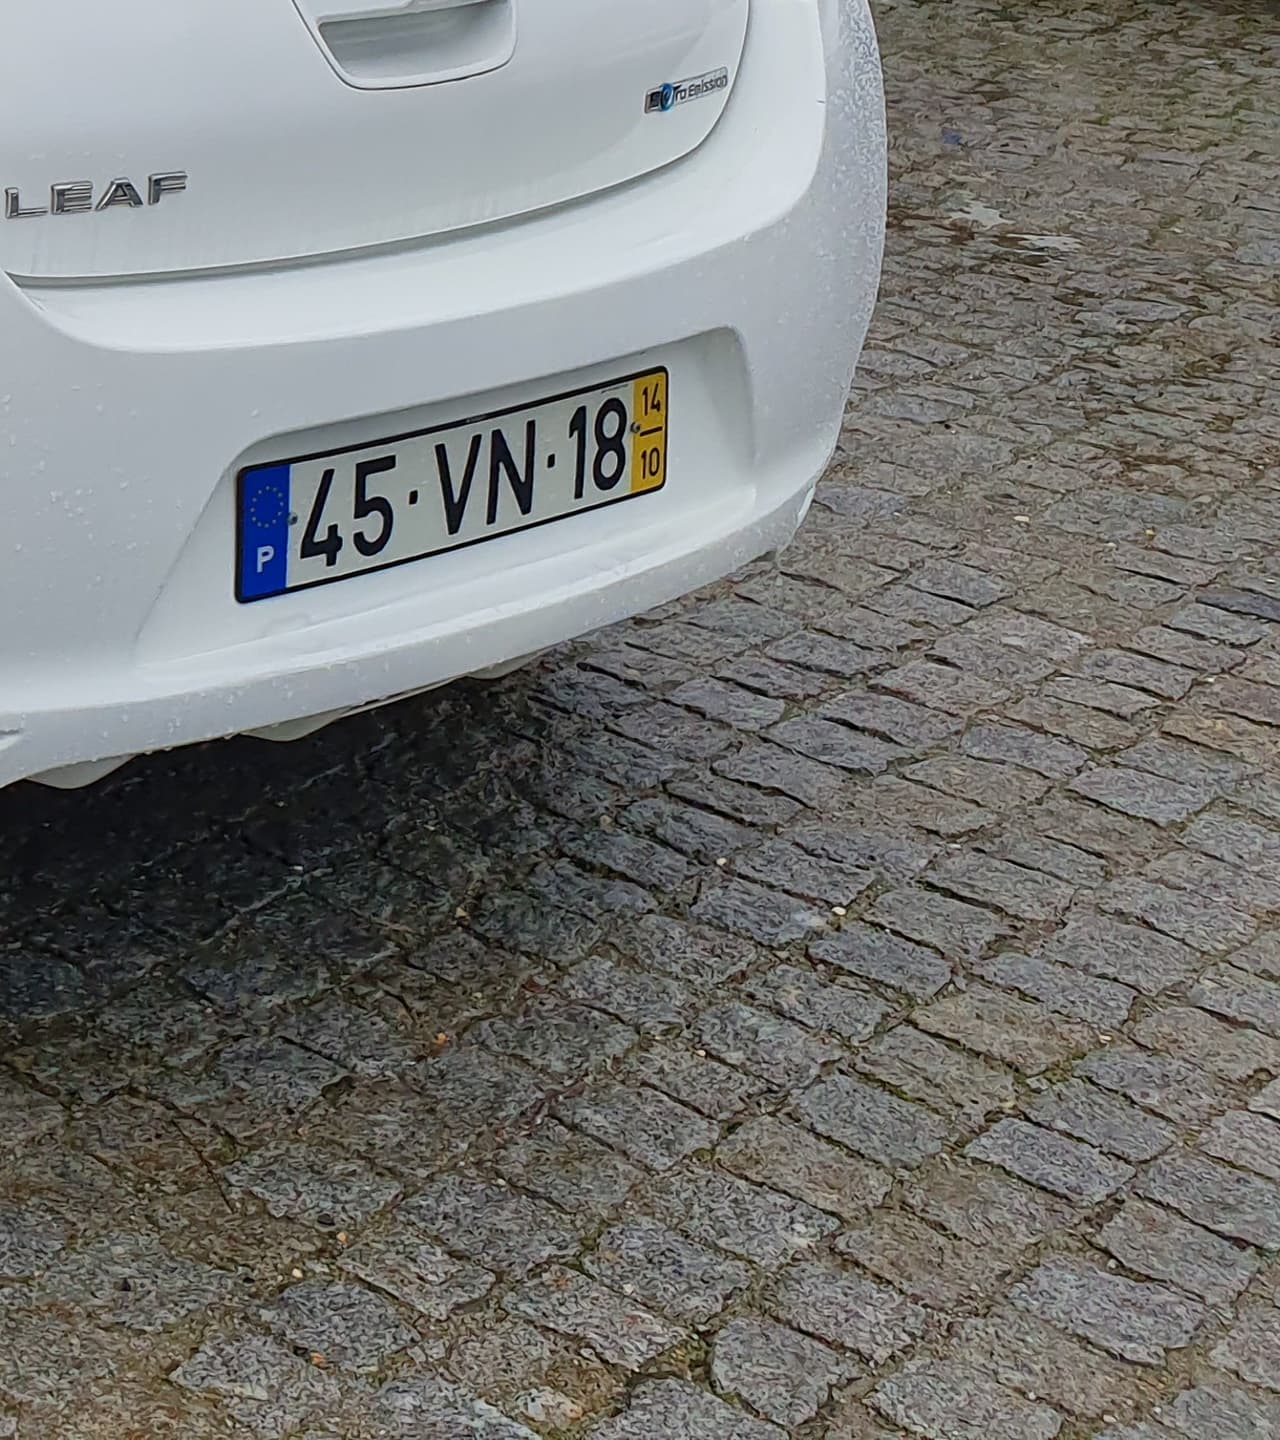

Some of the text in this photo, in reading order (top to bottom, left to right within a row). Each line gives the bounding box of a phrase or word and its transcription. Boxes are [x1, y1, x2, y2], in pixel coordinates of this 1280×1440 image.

[4, 171, 188, 219] LEAF
[642, 383, 661, 416] 14
[640, 448, 660, 479] 10
[299, 397, 628, 568] 45·VN·18
[256, 545, 275, 573] P
